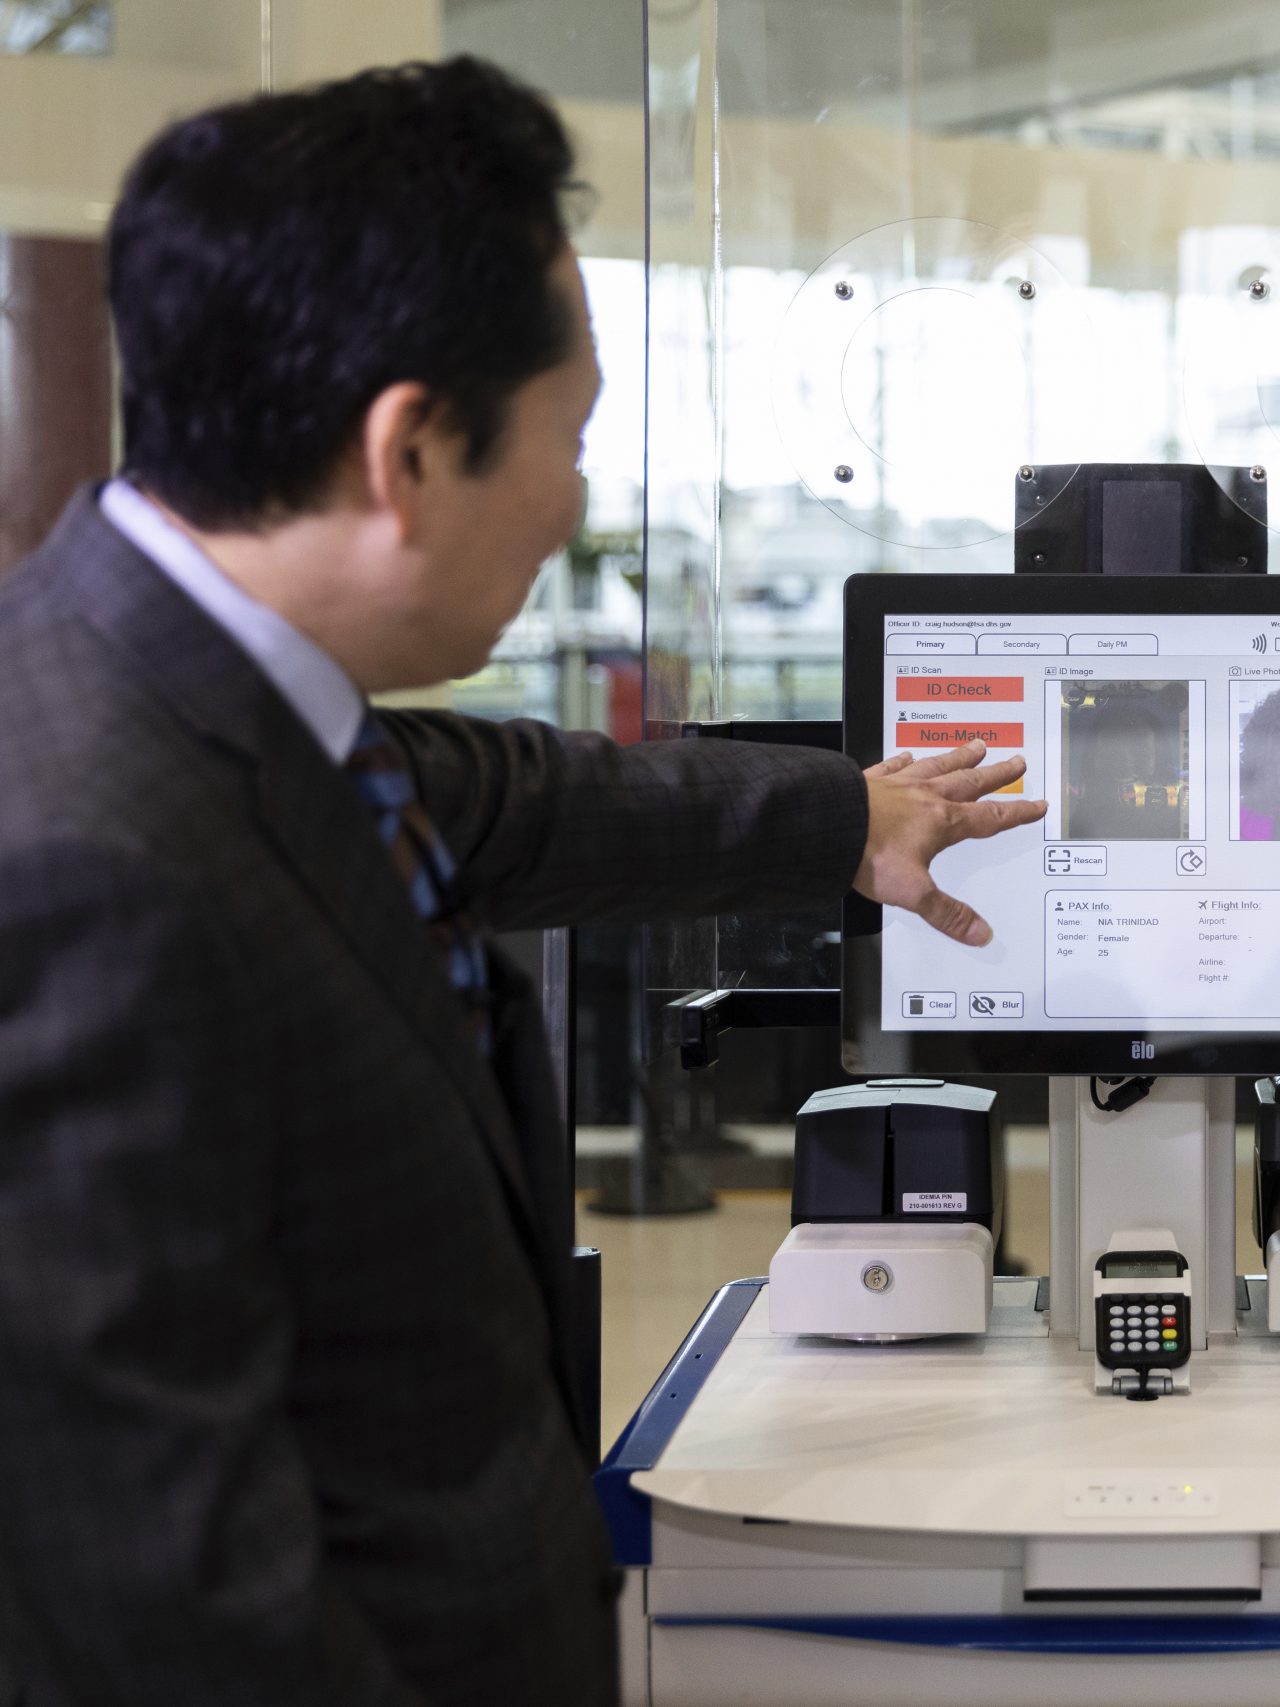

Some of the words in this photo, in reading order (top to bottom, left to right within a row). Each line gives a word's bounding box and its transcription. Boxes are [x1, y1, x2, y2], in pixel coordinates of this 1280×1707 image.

[916, 640, 944, 649] Primary
[1003, 640, 1040, 649] Secondary
[1098, 640, 1113, 649] Daily
[1069, 668, 1093, 676] Image
[928, 683, 941, 696] ID
[947, 683, 992, 696] Check
[920, 730, 997, 741] Non-Match
[1211, 901, 1239, 911] Flight
[1241, 901, 1261, 909] Info:
[1198, 917, 1227, 926] Airport:
[1198, 933, 1240, 942] Departure:
[1198, 974, 1221, 983] Flight
